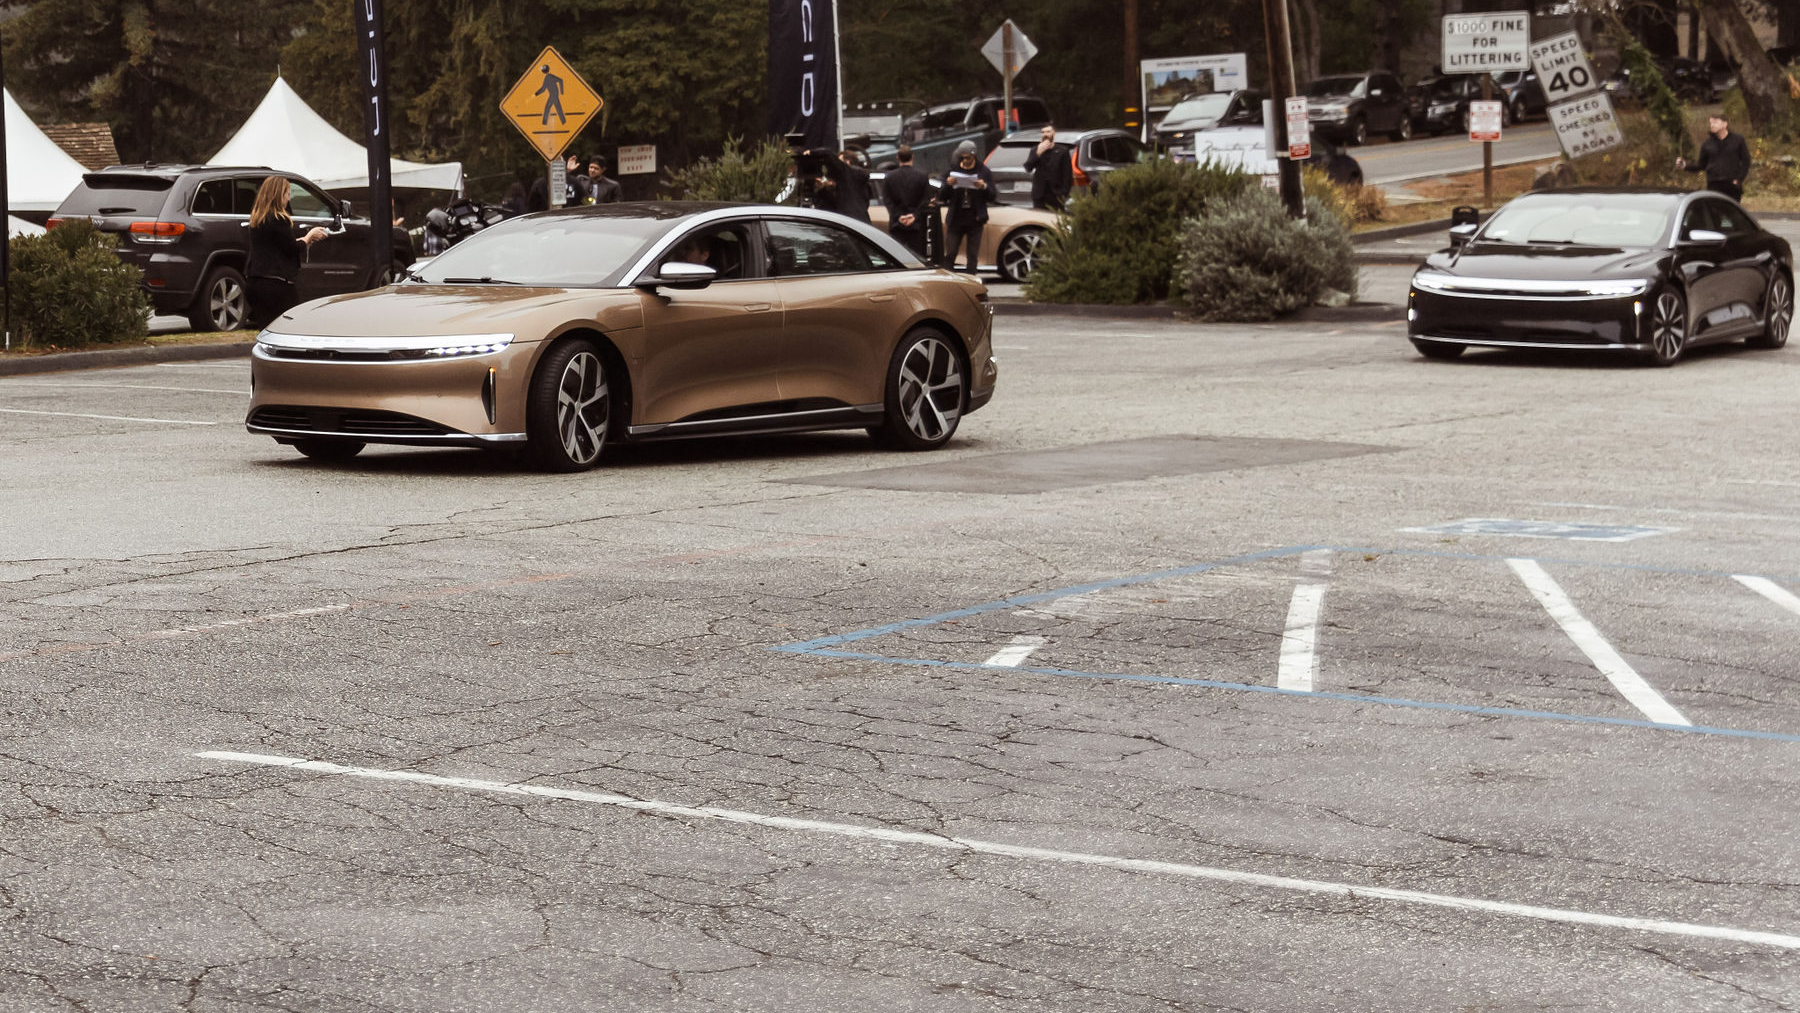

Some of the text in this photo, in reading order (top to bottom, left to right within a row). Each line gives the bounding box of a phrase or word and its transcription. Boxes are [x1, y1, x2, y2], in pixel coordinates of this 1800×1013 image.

[1447, 19, 1525, 35] $1000 FINE
[1472, 37, 1498, 49] FOR
[1531, 38, 1578, 60] SPEED
[1449, 52, 1522, 66] LITTERING
[1540, 51, 1578, 72] LIMIT
[1548, 66, 1590, 93] 40
[1560, 100, 1600, 118] SPEED
[1572, 135, 1615, 154] RADAR
